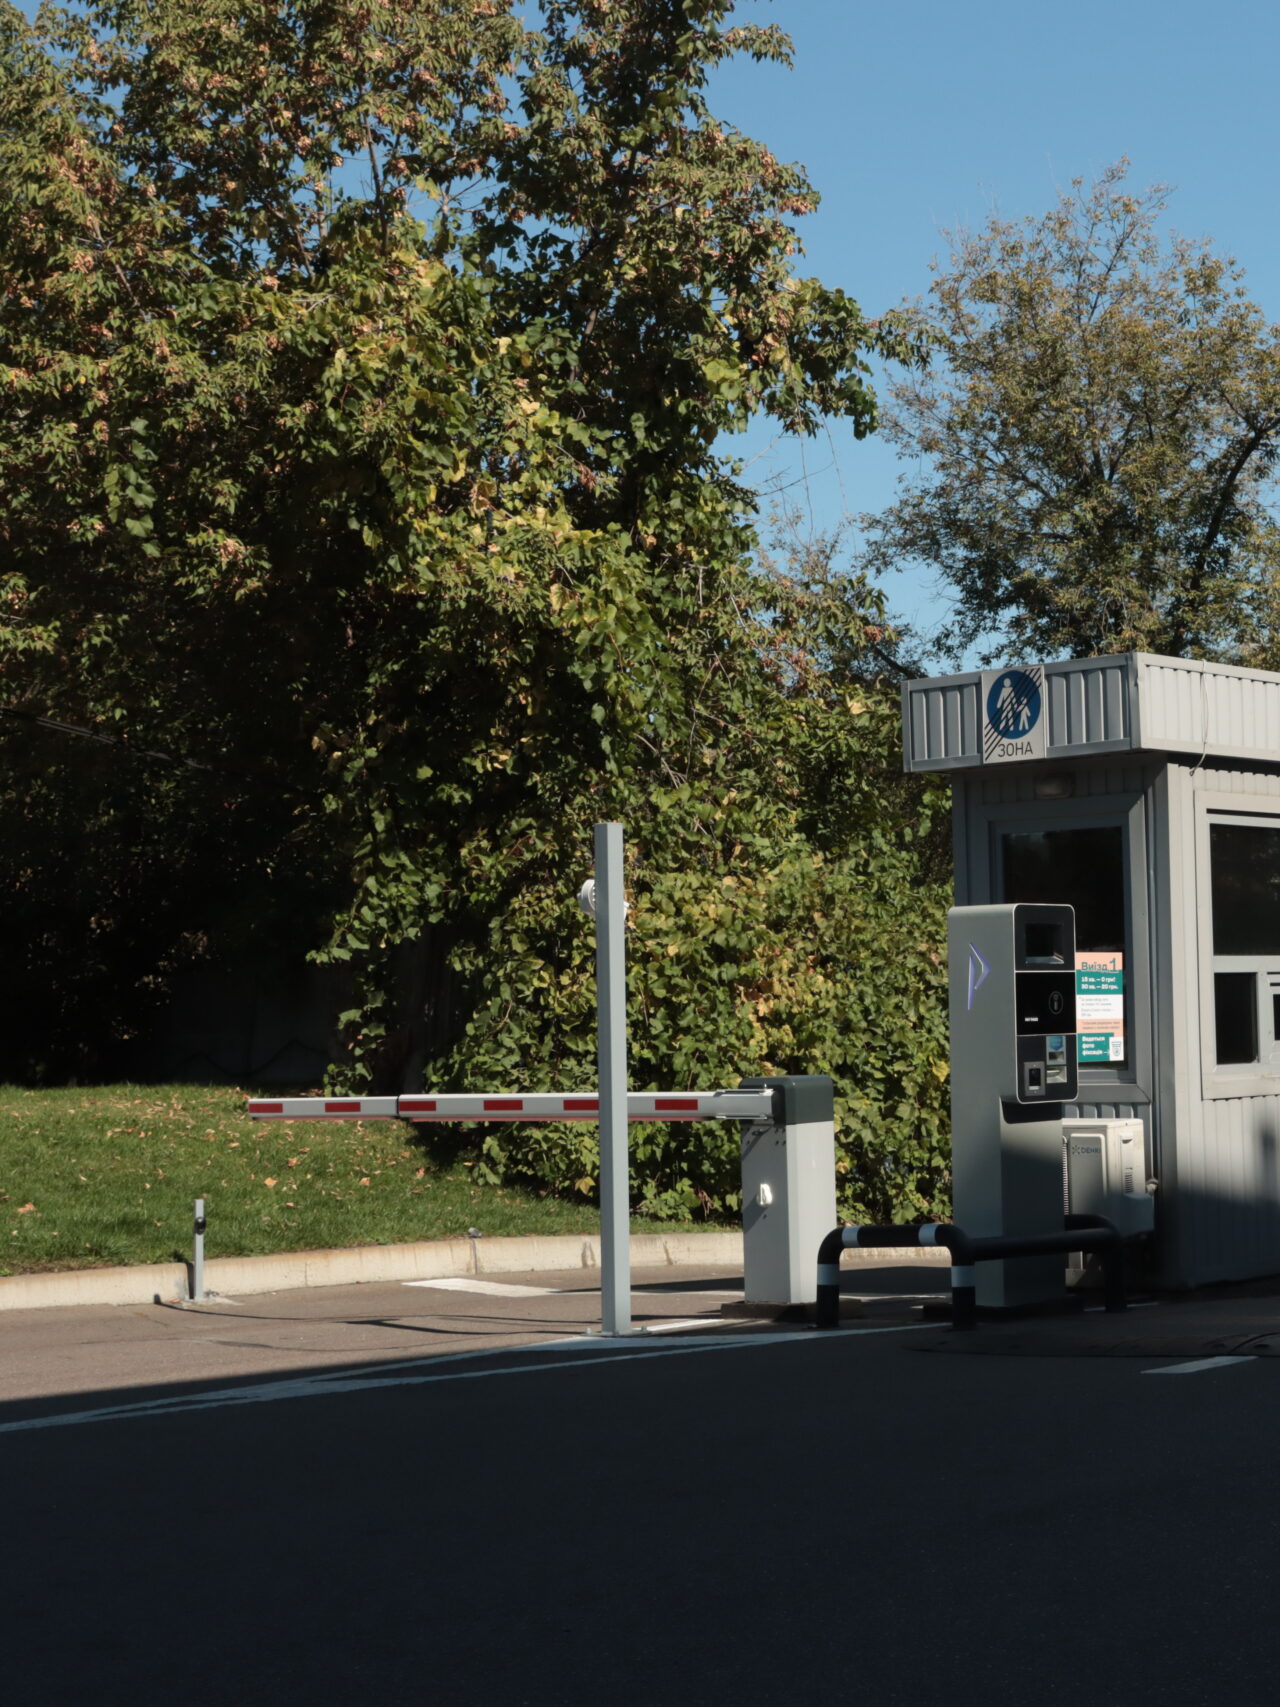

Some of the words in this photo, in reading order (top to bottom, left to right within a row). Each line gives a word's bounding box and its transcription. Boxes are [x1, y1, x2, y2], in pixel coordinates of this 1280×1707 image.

[997, 742, 1033, 757] ЗОНА
[1081, 961, 1108, 972] Виїзд
[1109, 957, 1117, 972] 1
